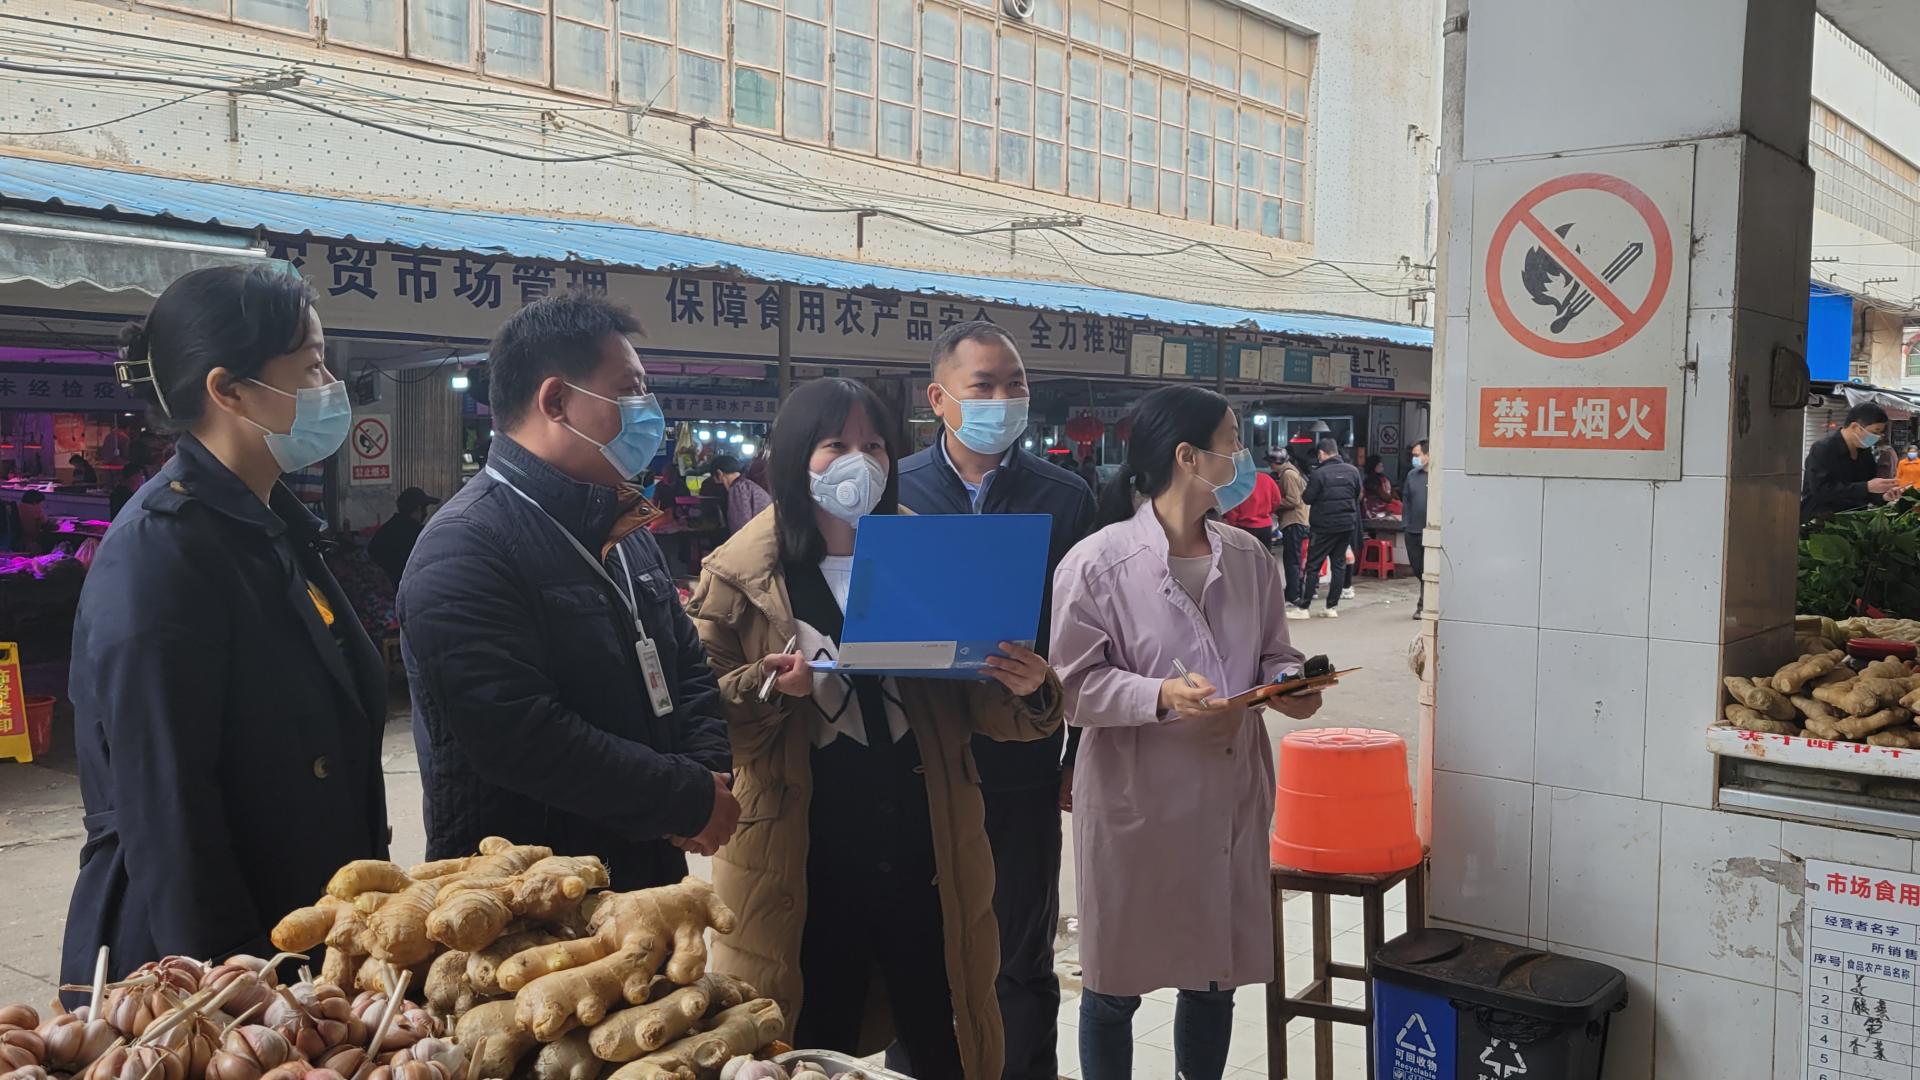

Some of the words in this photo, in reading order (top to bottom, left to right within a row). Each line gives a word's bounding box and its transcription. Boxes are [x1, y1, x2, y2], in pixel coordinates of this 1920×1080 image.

[1493, 397, 1652, 439] 禁止烟火
[1826, 873, 1920, 906] 市场食用
[1825, 915, 1899, 936] 经营者名字
[1814, 953, 1841, 967] 序号
[1871, 943, 1918, 960] 所销售
[1847, 958, 1910, 980] 食品农产品名称
[1823, 975, 1829, 984] 1
[1821, 994, 1829, 1004] 2
[1820, 1015, 1829, 1024] 3
[1820, 1034, 1828, 1044] 4
[1395, 1048, 1437, 1072] 可回收物
[1820, 1054, 1828, 1064] 5
[1395, 1060, 1436, 1080] Recyclable
